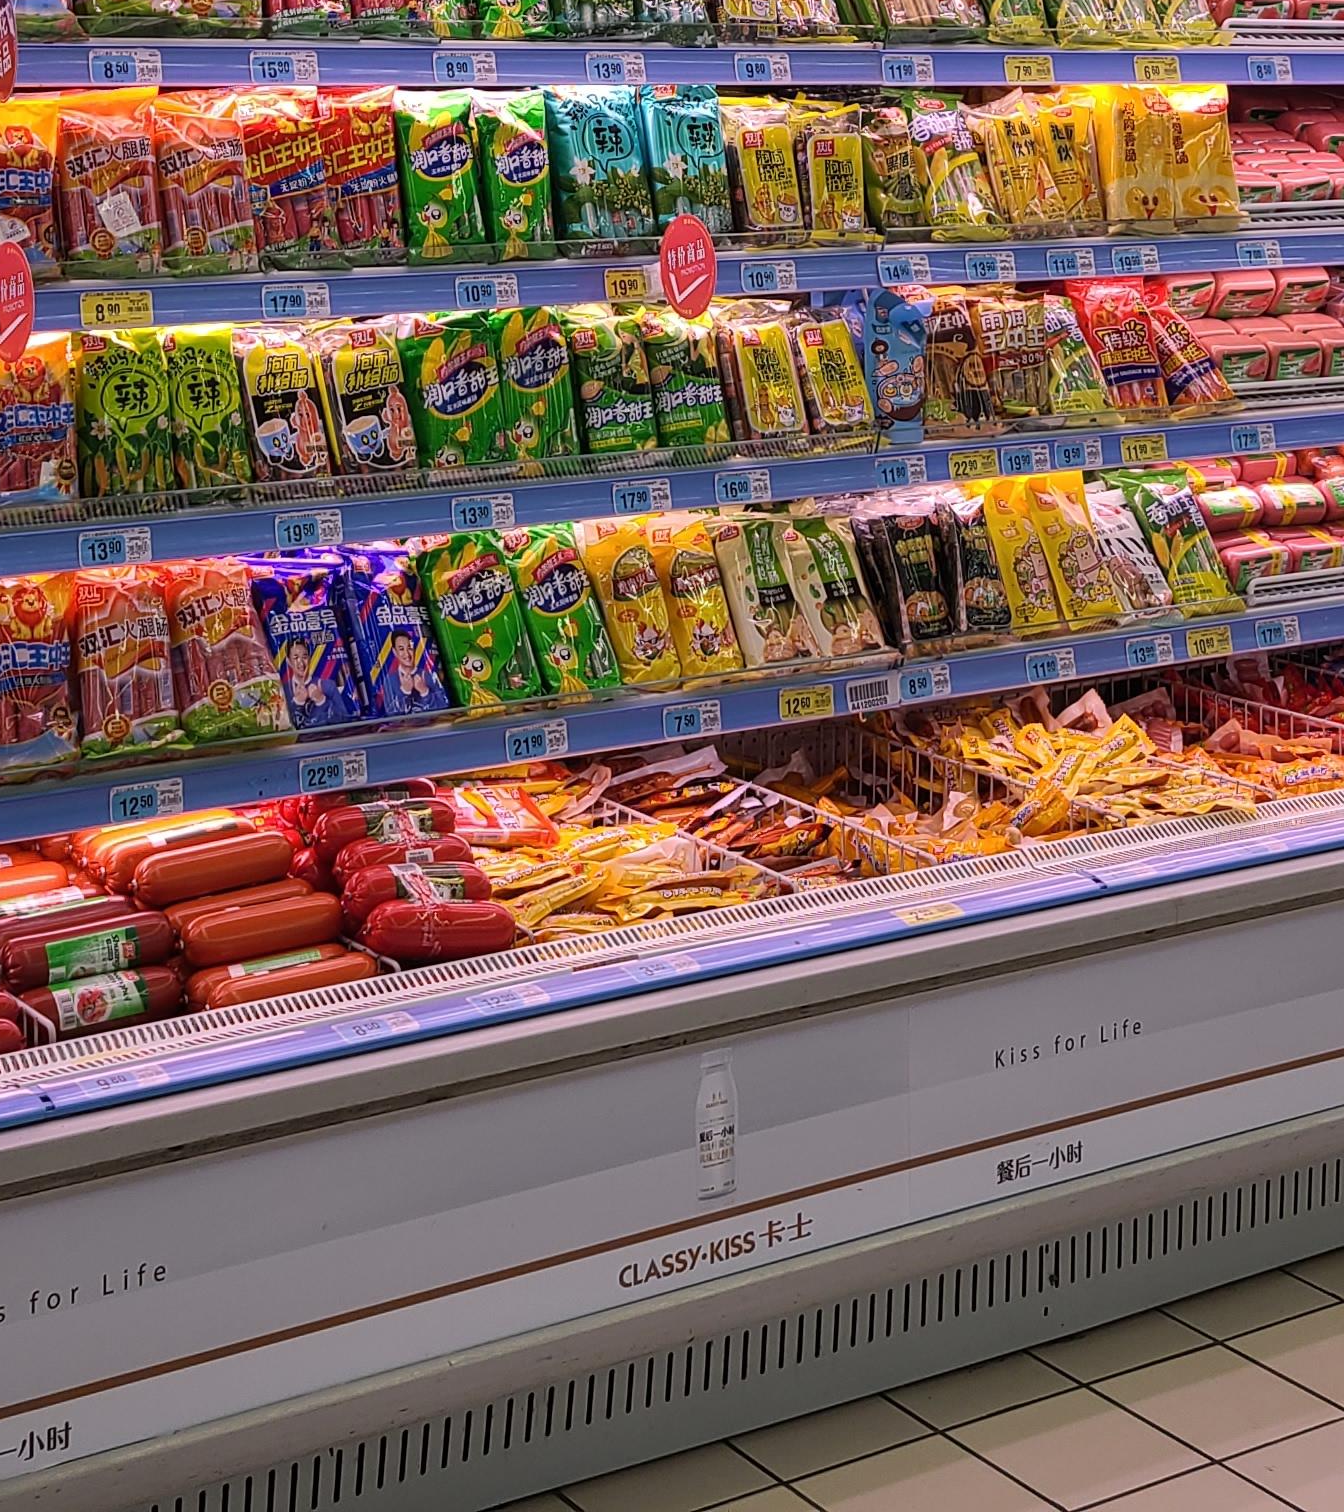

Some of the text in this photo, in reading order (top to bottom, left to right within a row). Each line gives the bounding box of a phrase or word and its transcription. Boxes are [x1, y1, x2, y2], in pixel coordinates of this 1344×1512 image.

[593, 118, 625, 156] 辣
[815, 138, 833, 157] 双汇
[667, 238, 706, 272] 特价商品
[980, 308, 1028, 331] 雨润
[349, 328, 376, 348] 双汇
[982, 325, 1047, 354] 王中王
[265, 354, 299, 373] 泡面
[355, 349, 390, 372] 泡面
[113, 377, 150, 415] 辣
[186, 377, 222, 414] 辣
[268, 608, 339, 636] 金品壹号
[994, 1018, 1144, 1069] Kiss for Life
[995, 1140, 1084, 1185] 餐后一小时
[758, 1210, 813, 1249] 卡士
[28, 1281, 84, 1319] for
[101, 1260, 171, 1297] Life
